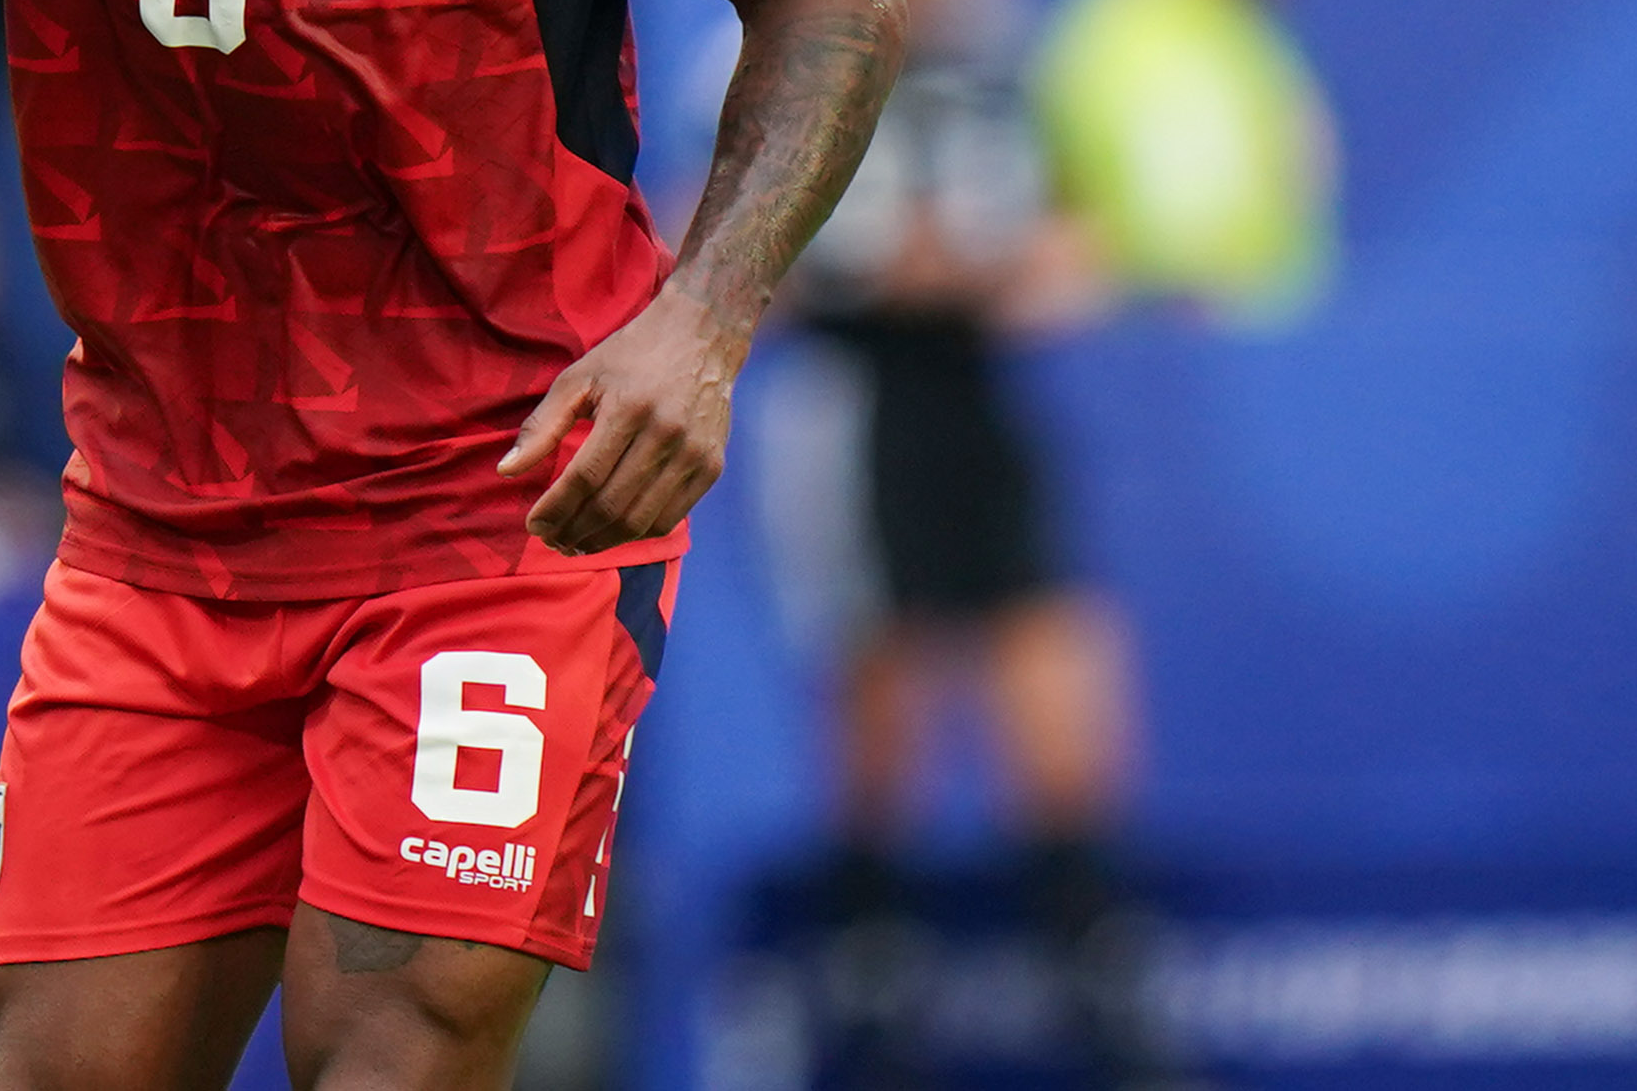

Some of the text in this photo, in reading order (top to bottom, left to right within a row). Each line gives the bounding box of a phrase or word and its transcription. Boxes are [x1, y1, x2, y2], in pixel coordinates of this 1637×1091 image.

[411, 651, 547, 829] 6
[400, 837, 536, 880] capelli
[459, 871, 532, 893] SPORT
